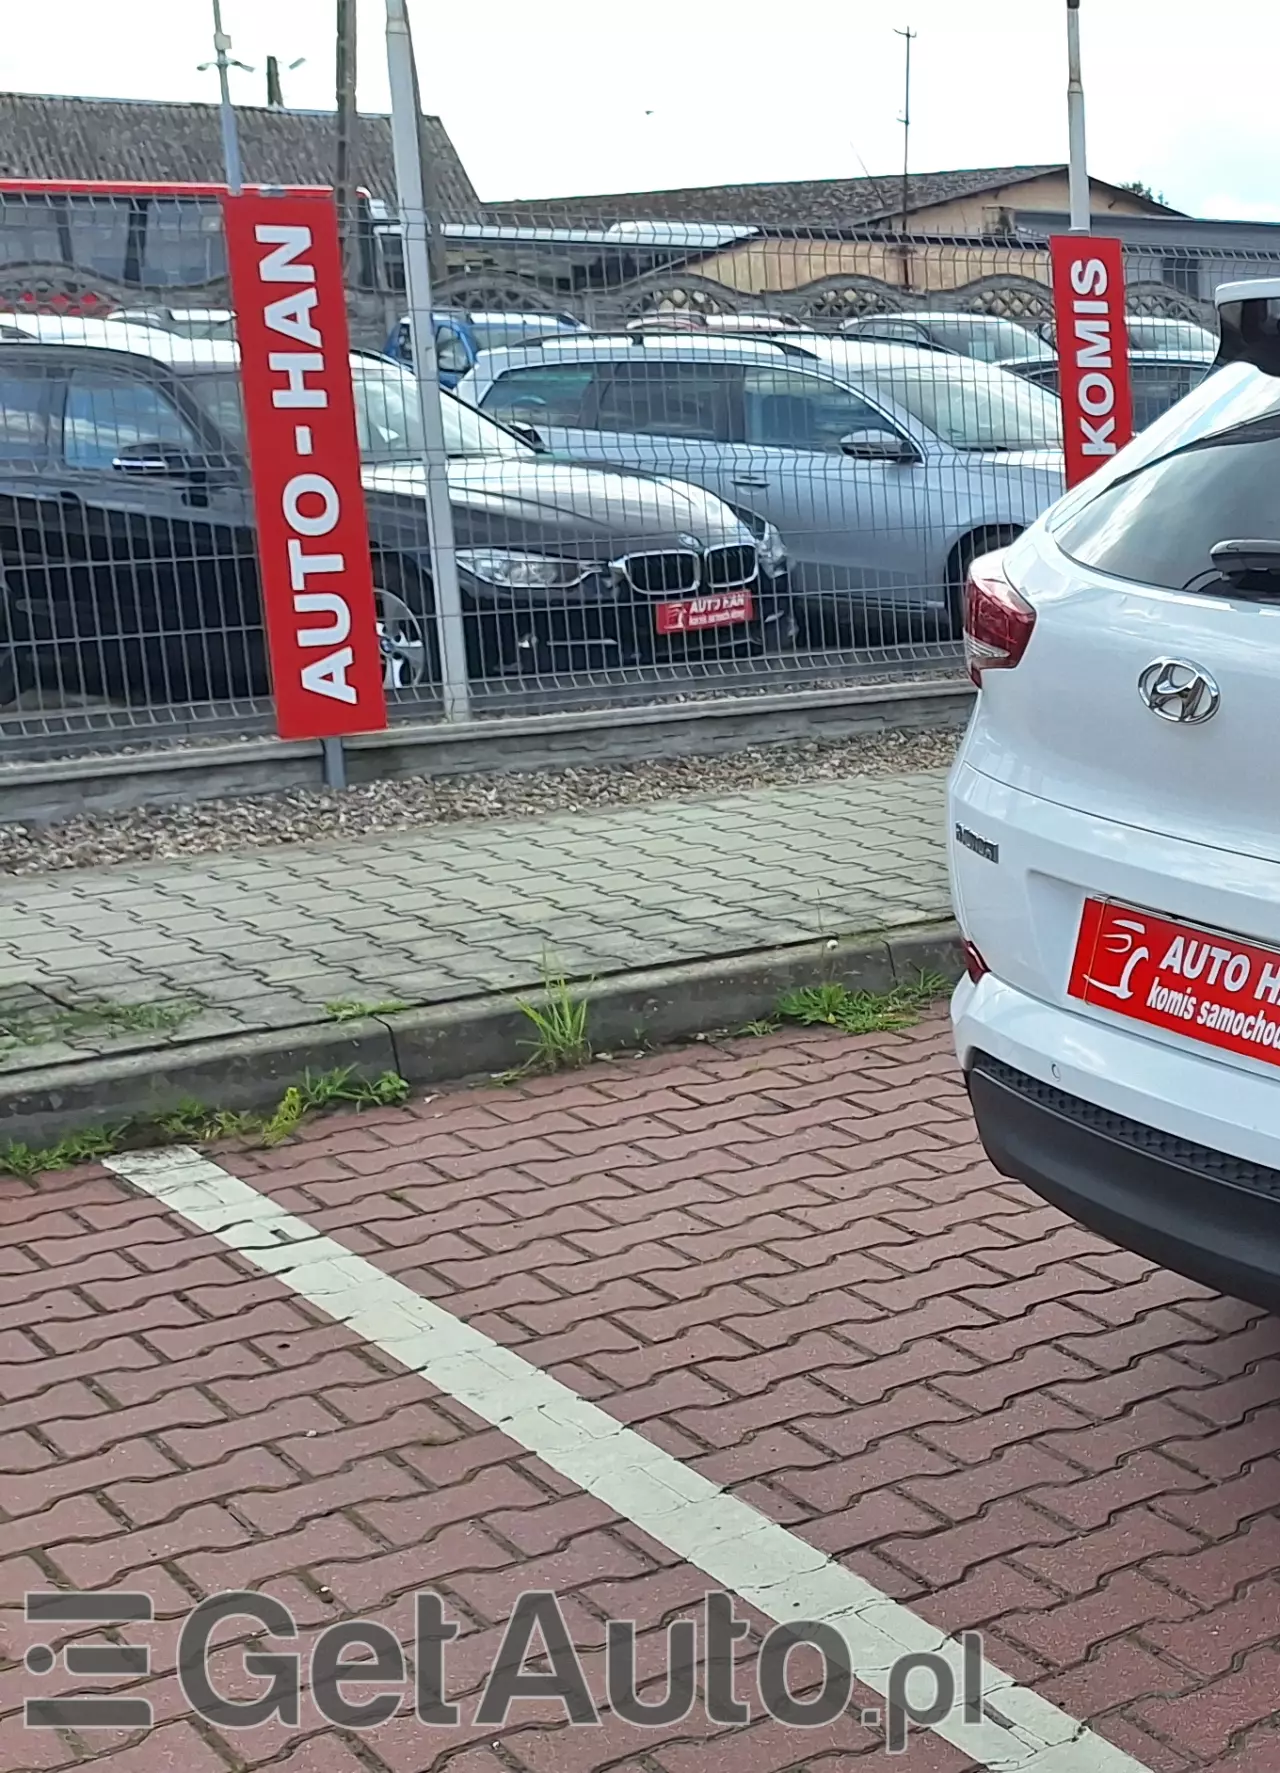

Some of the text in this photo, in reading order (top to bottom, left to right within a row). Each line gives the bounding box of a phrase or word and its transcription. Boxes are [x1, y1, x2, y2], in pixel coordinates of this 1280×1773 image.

[1070, 258, 1117, 456] KOMIS
[1160, 936, 1250, 992] AUTO
[1146, 977, 1197, 1020] komis
